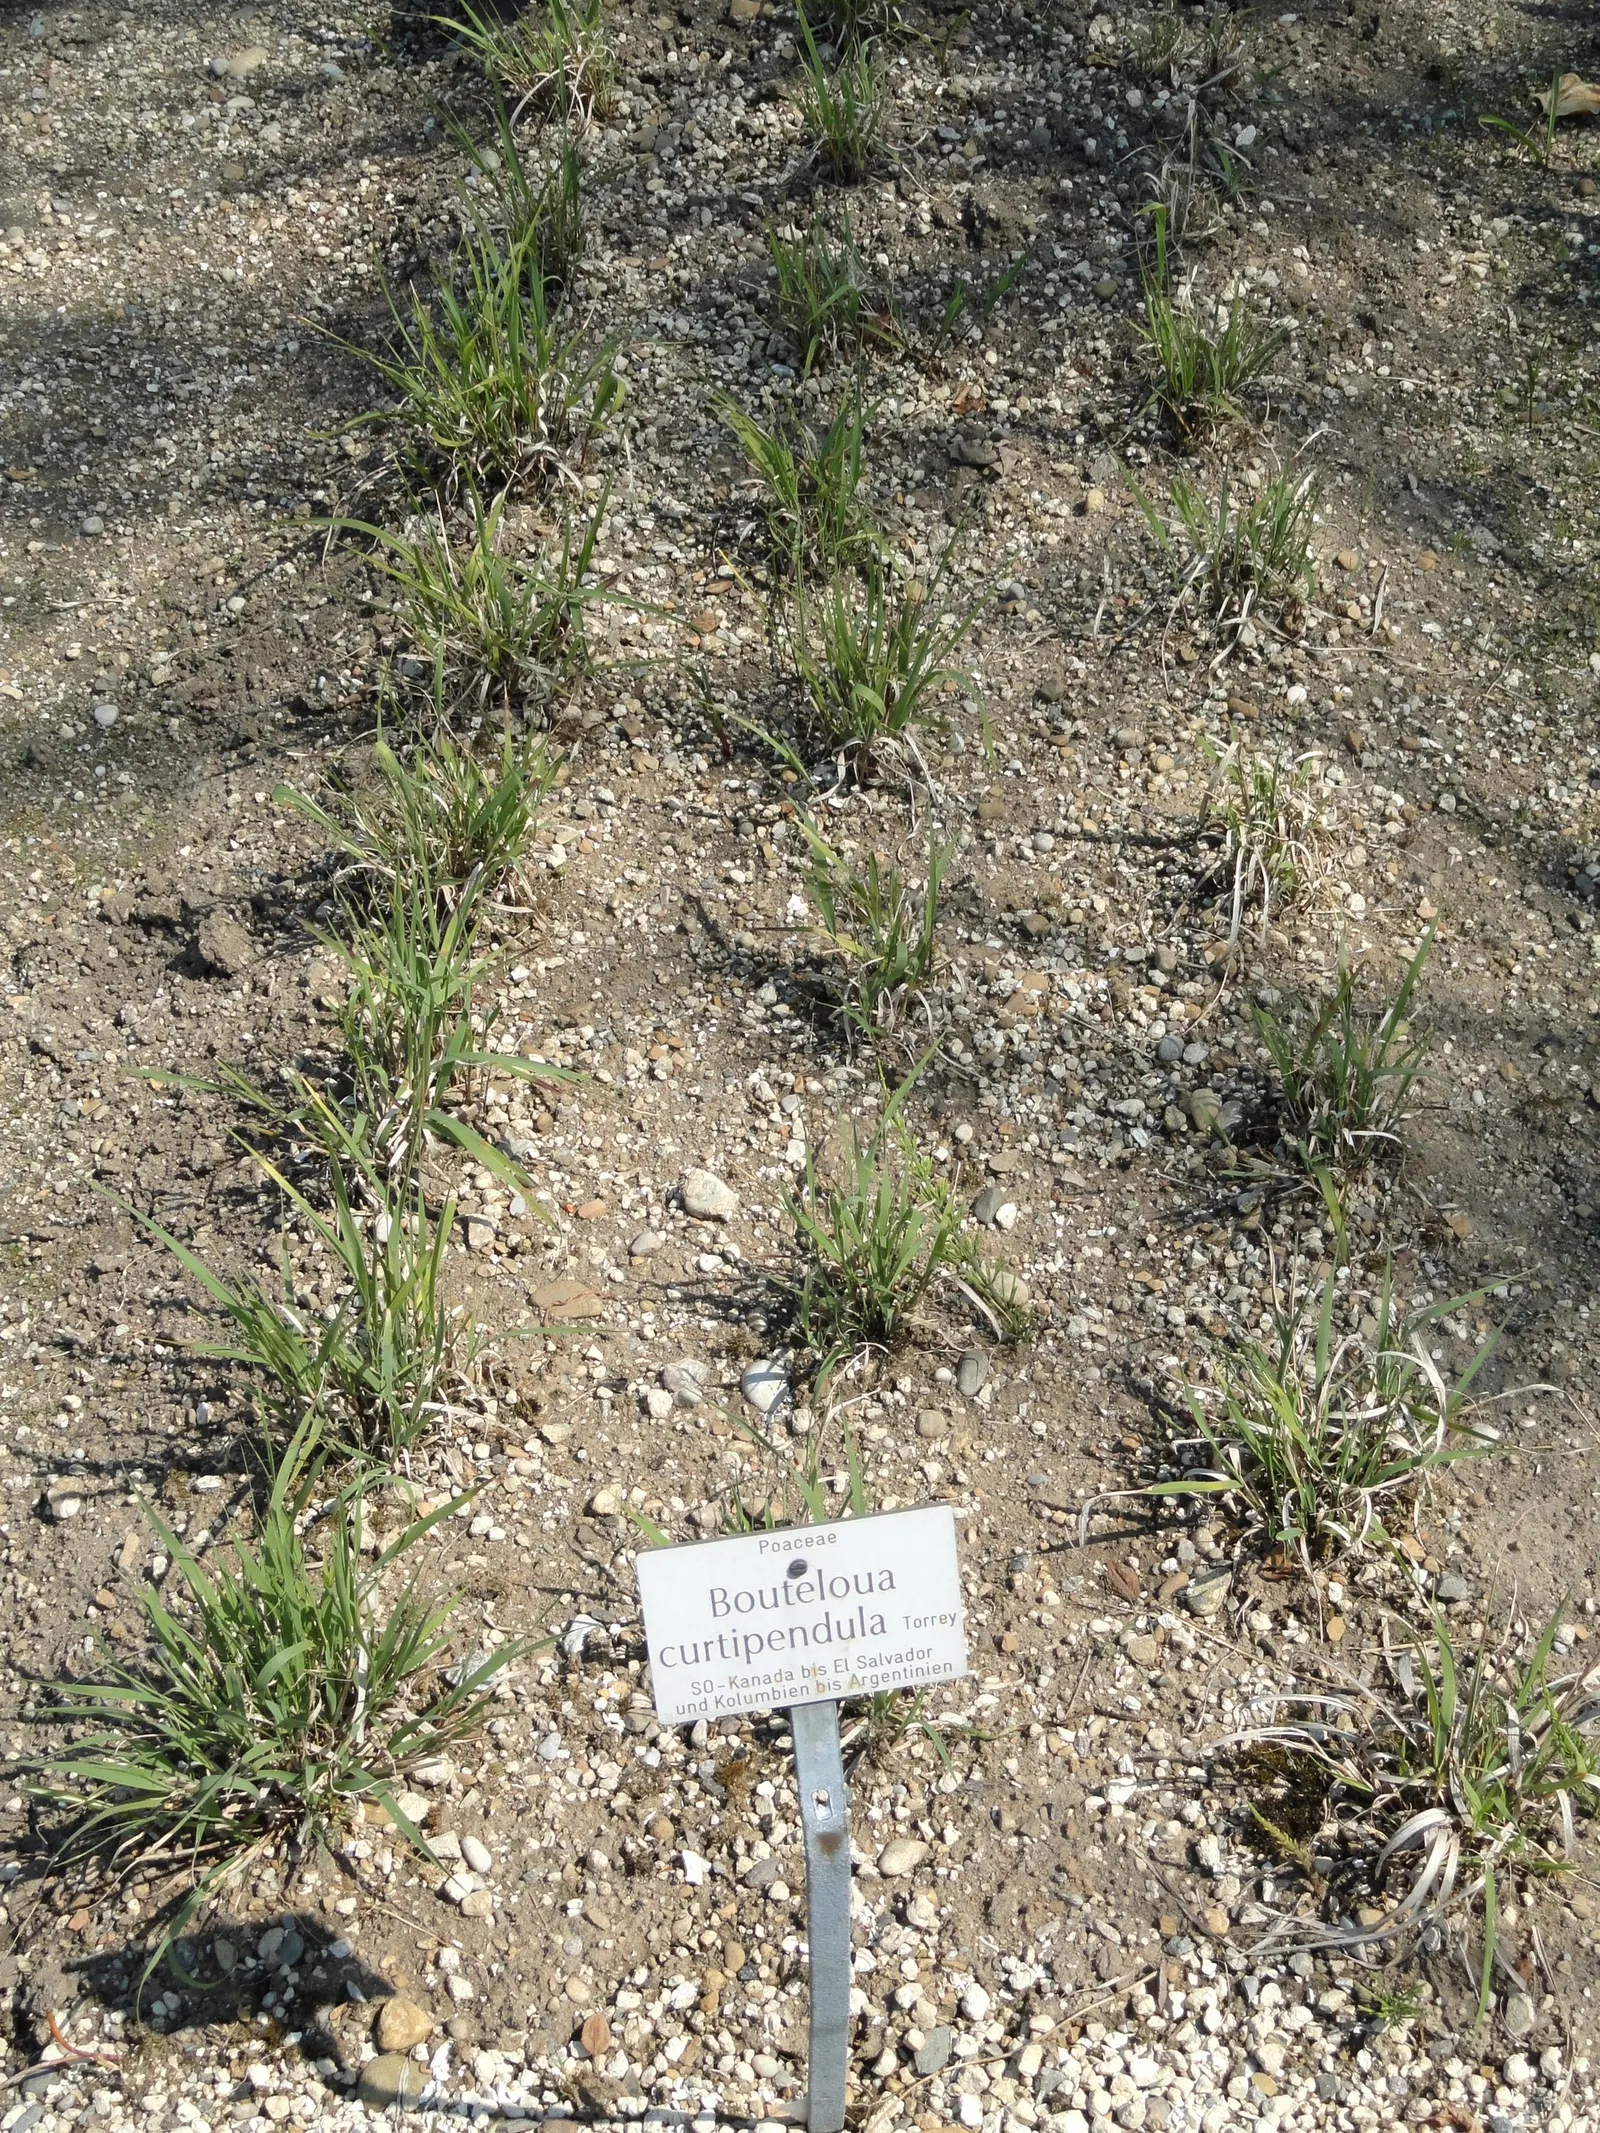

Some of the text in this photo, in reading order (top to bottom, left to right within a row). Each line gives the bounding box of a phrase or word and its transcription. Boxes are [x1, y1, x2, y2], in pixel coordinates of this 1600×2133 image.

[758, 1532, 837, 1554] Poaceae
[709, 1568, 896, 1618] Bouteloua
[659, 1606, 957, 1668] curtipendula Torrey
[801, 1662, 827, 1679] bis
[834, 1658, 850, 1674] El
[857, 1646, 933, 1670] Salvador
[676, 1662, 953, 1716] und Kolumbien bis Argentinien
